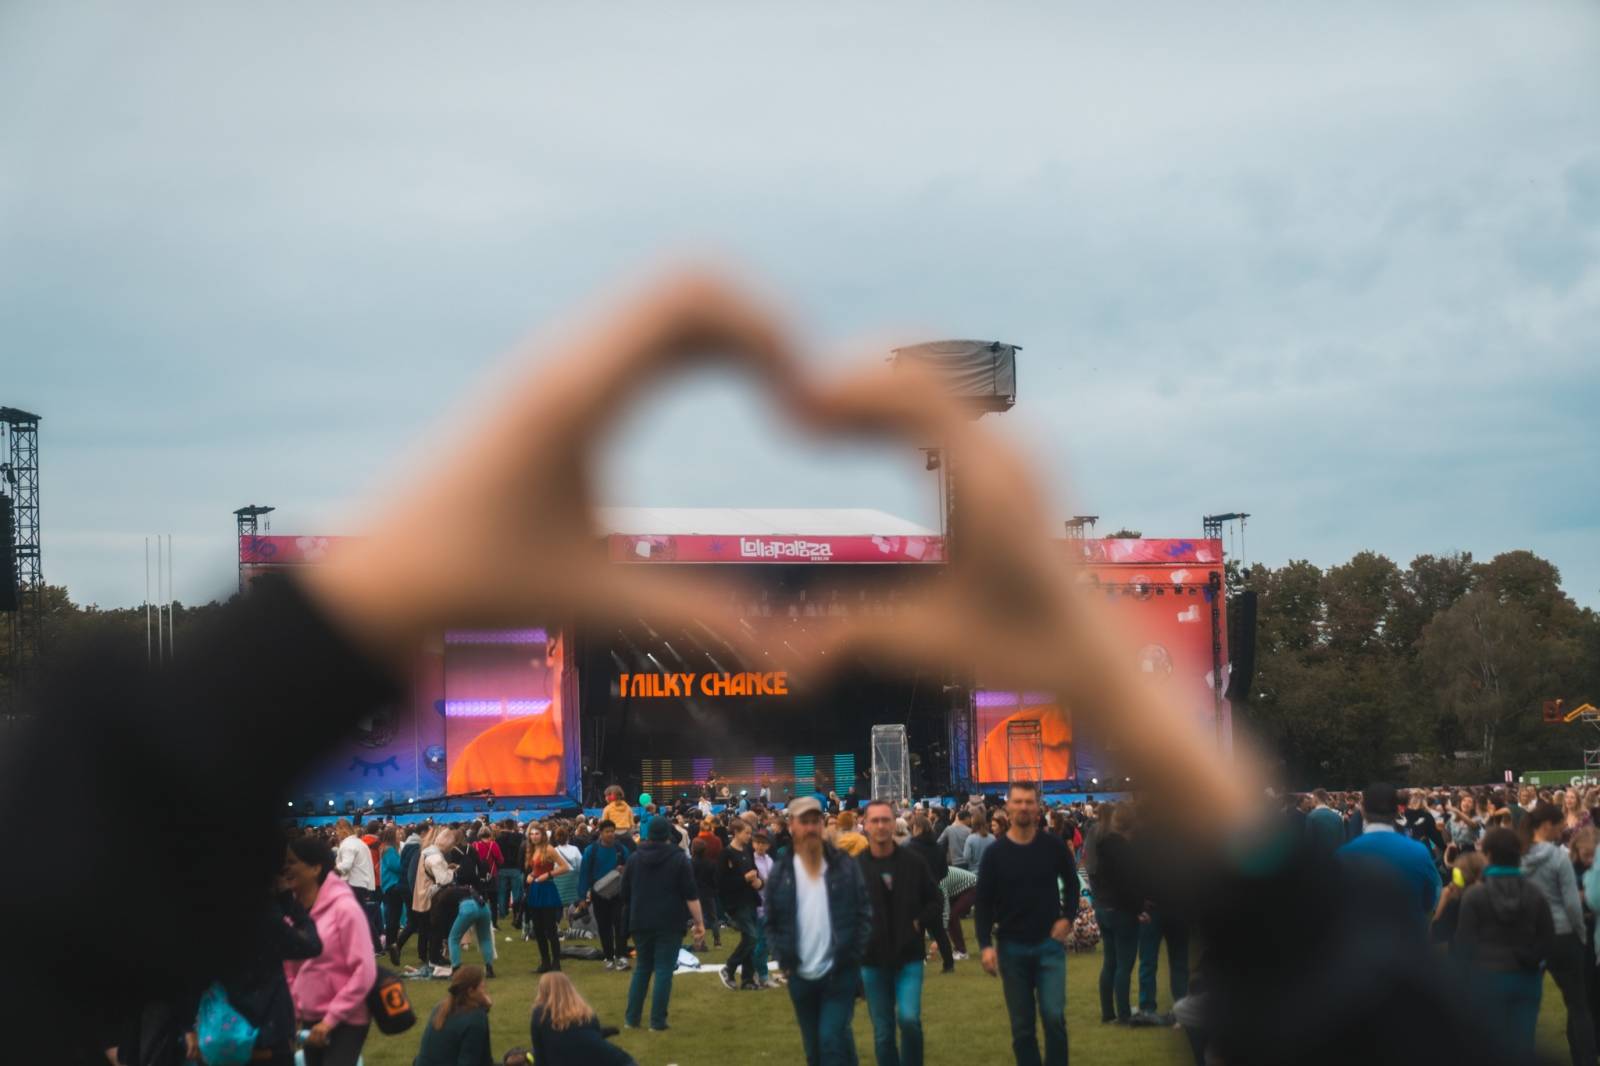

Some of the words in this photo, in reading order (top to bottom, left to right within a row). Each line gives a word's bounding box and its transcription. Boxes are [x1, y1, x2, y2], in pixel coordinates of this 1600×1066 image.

[740, 537, 833, 559] Lollapalooza
[620, 673, 696, 697] MILKY
[701, 671, 788, 696] CHANCE
